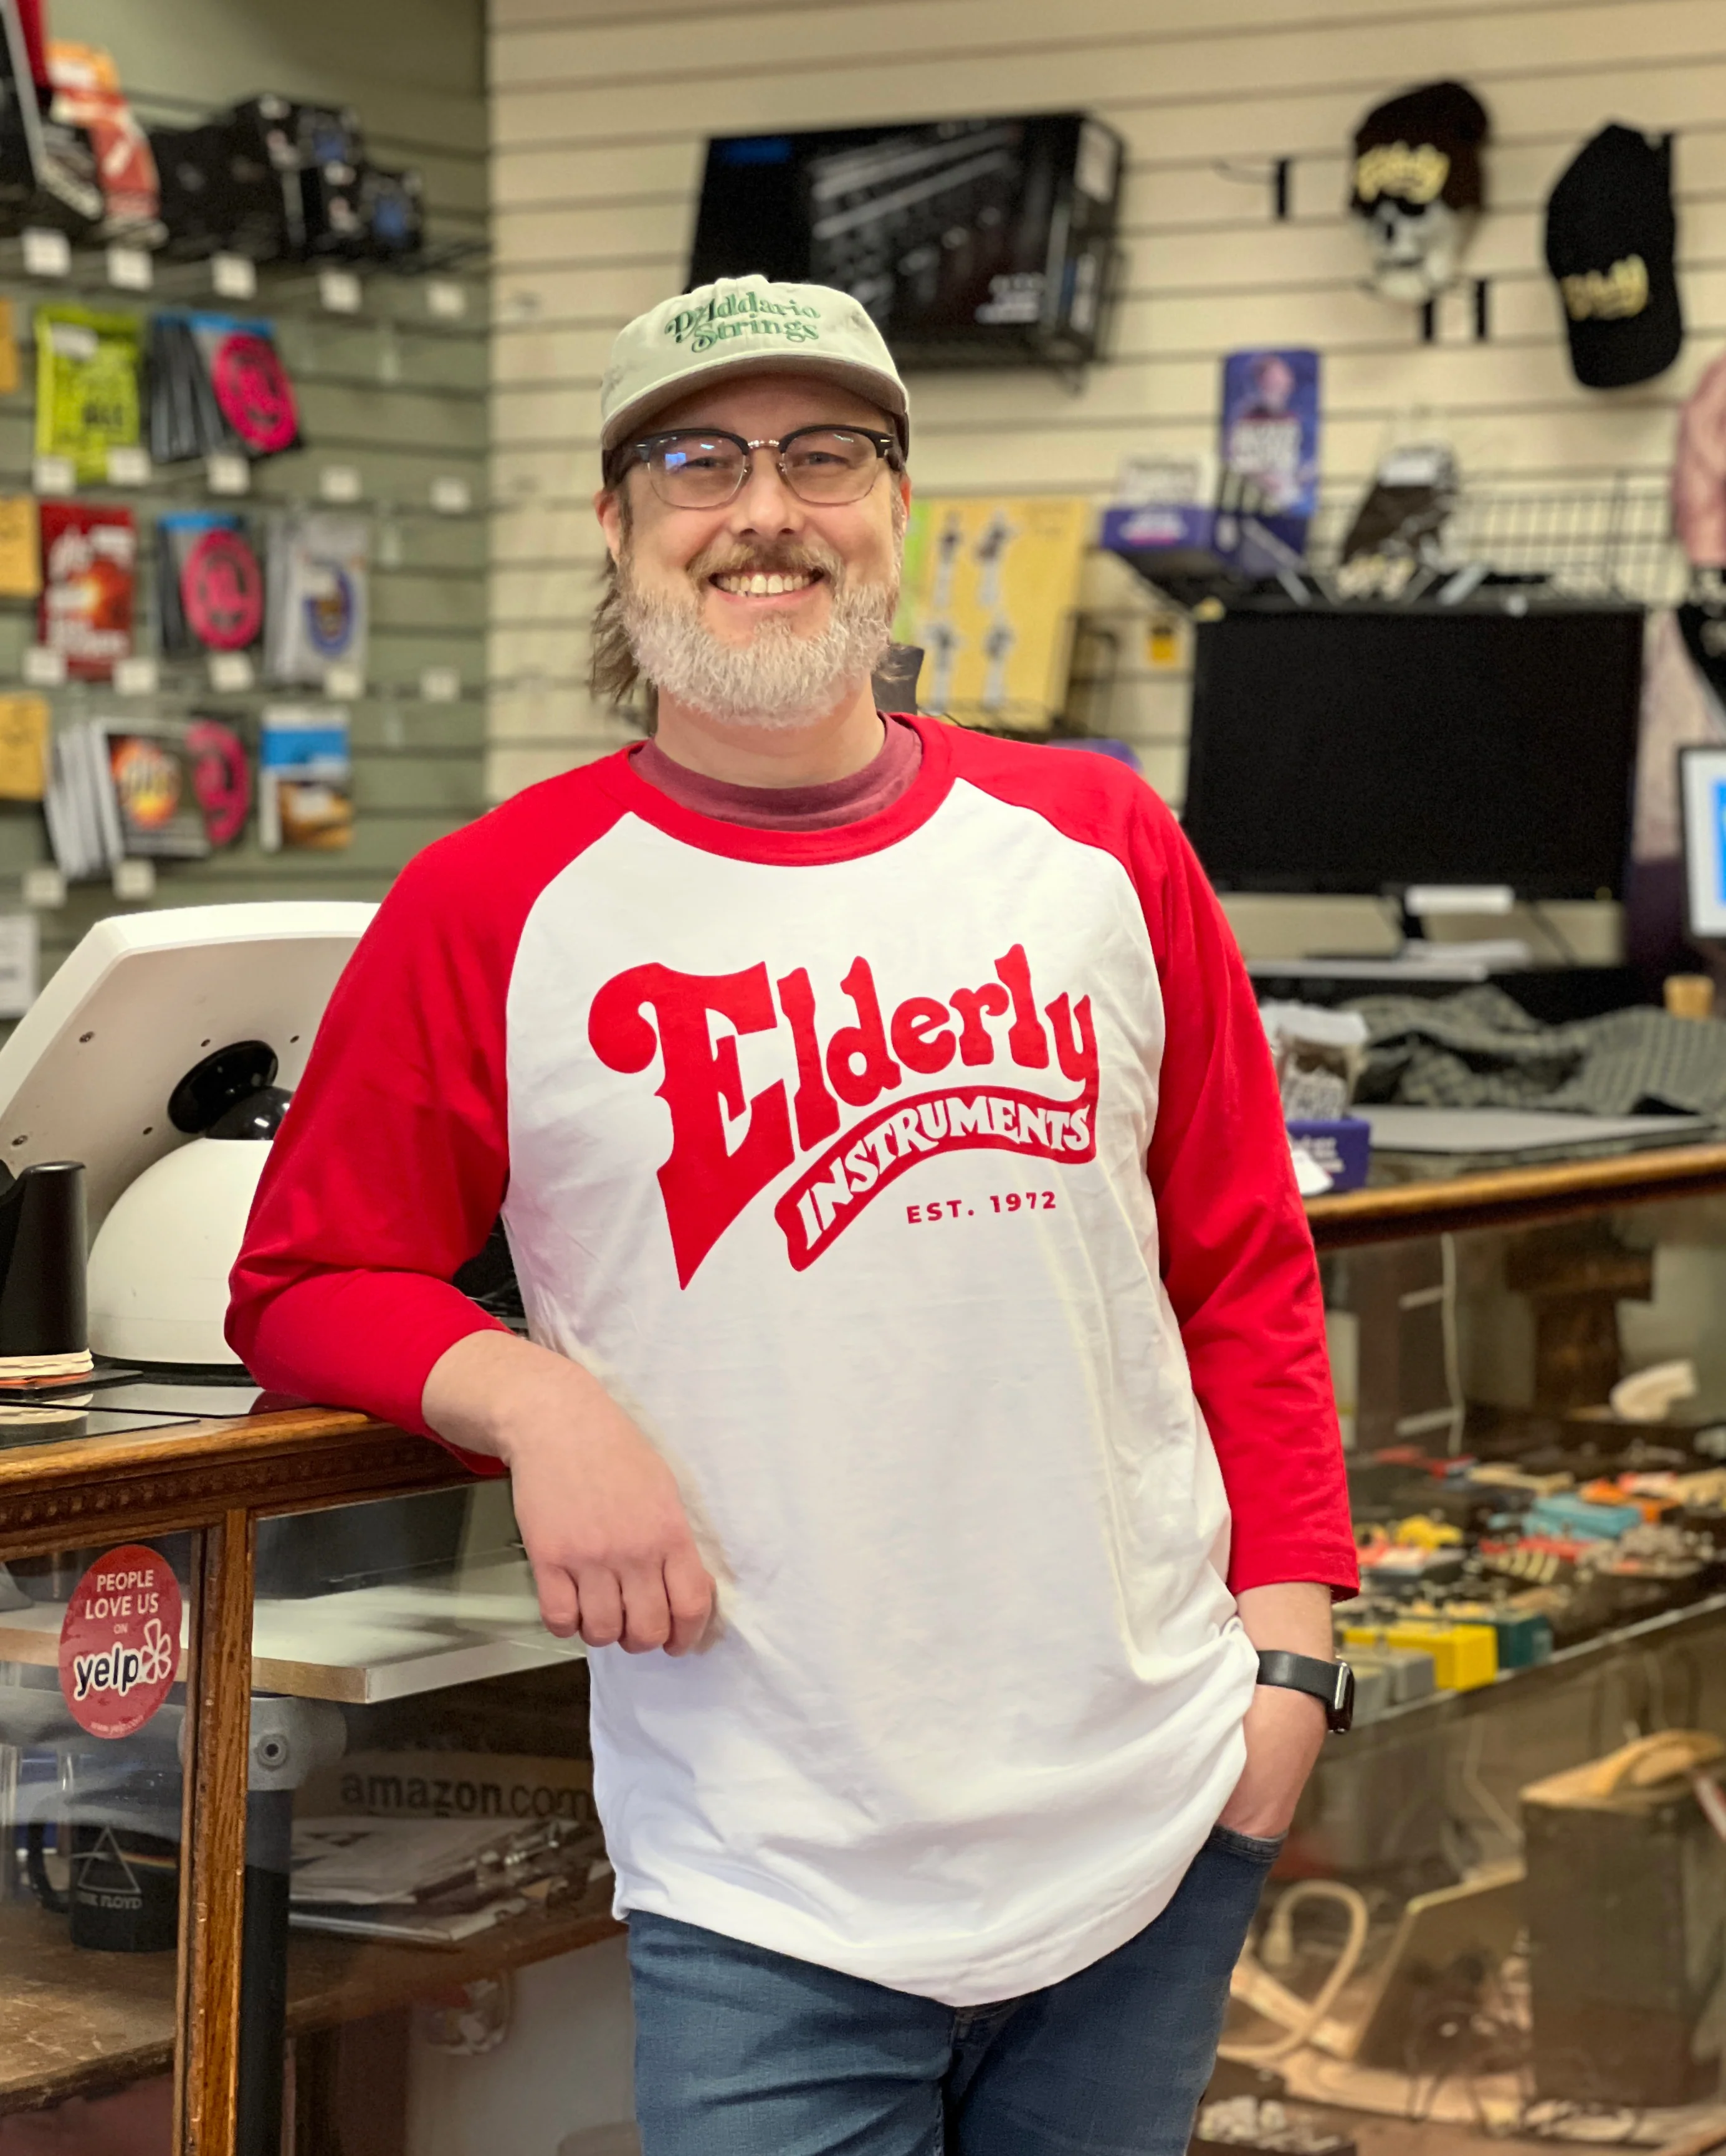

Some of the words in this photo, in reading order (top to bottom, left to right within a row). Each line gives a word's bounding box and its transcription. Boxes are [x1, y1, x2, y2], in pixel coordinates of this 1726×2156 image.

[692, 313, 819, 353] Strings
[588, 943, 1100, 1290] Elderly
[796, 1095, 1090, 1251] INSTRUMENTS
[906, 1200, 975, 1224] EST.
[989, 1191, 1056, 1213] 1972
[97, 1569, 154, 1592] PEOPLE
[85, 1595, 133, 1619] LOVE
[137, 1593, 160, 1615] US
[113, 1623, 128, 1634] ON
[75, 1646, 140, 1699] yelp
[340, 1772, 593, 1823] amazon.com
